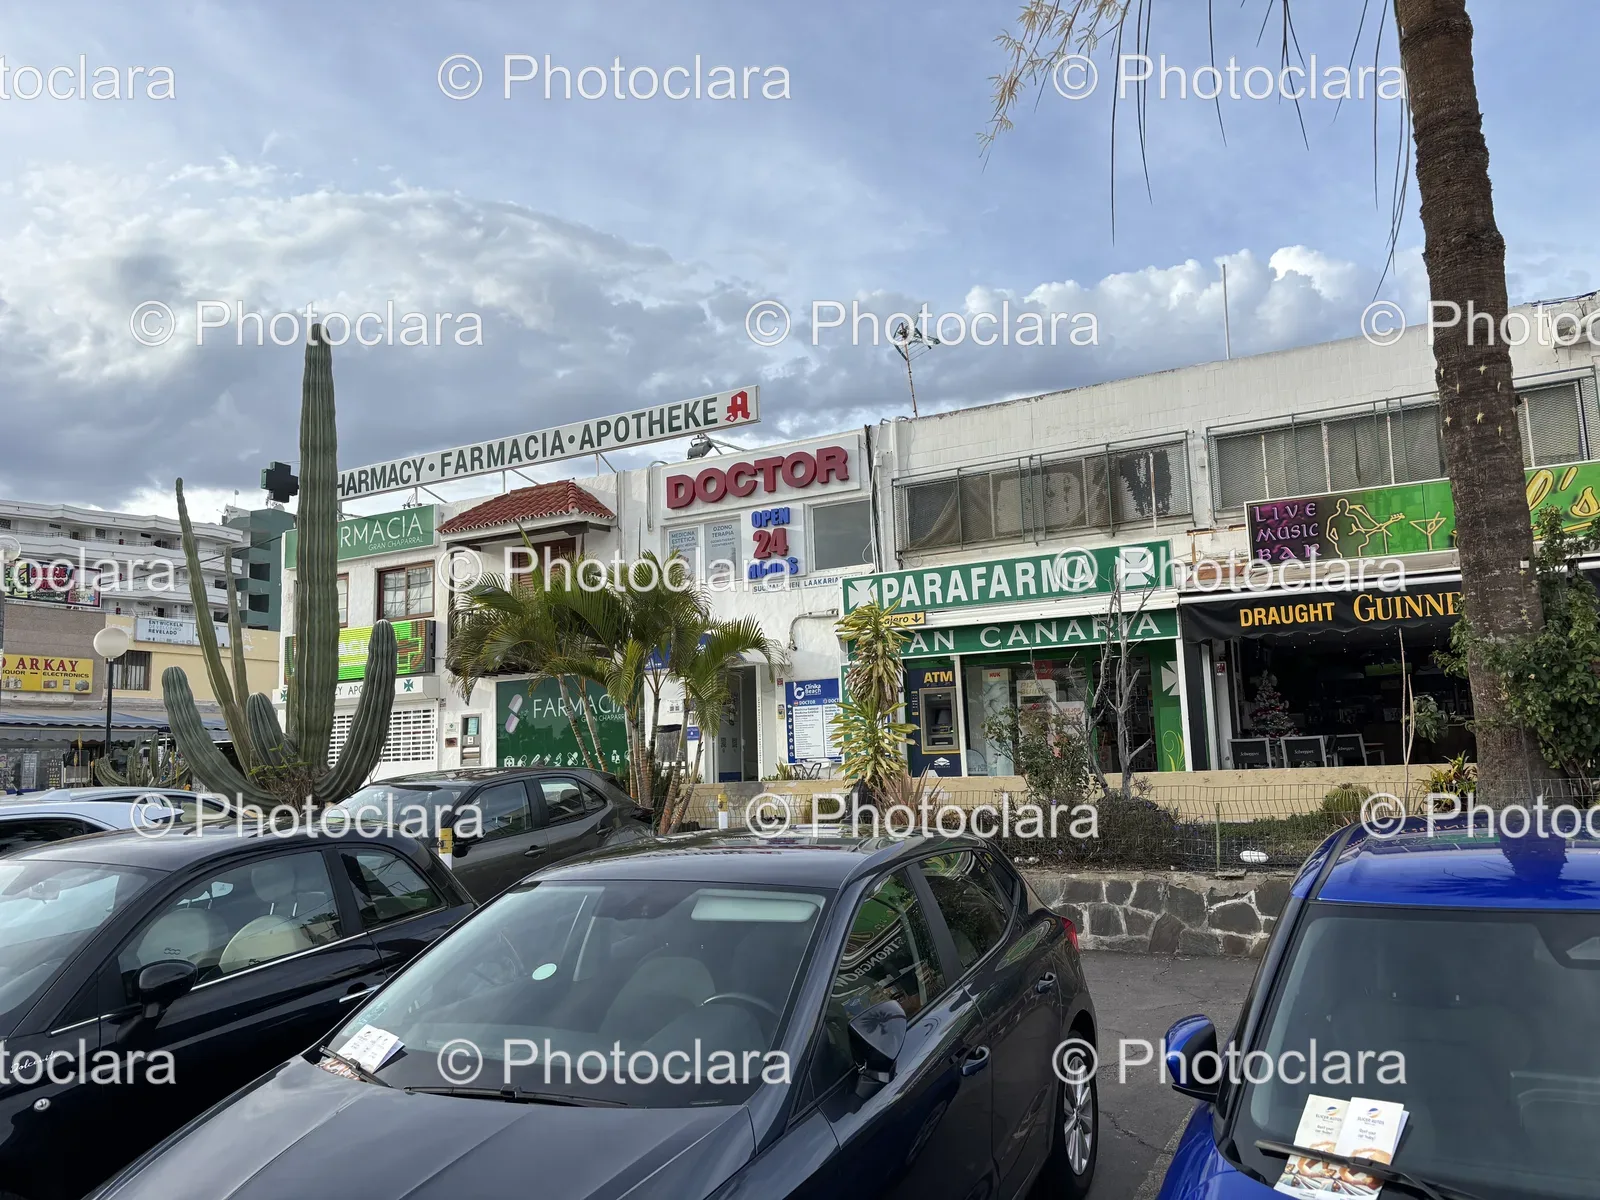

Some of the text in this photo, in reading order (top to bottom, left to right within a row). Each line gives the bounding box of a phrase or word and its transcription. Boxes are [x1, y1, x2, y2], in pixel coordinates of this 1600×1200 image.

[337, 457, 425, 497] HARMACY
[441, 429, 564, 477] FARMACIA
[579, 396, 718, 451] APOTHEKE
[667, 446, 849, 509] DOCTOR
[752, 507, 790, 528] OPEN
[1253, 503, 1317, 522] LIVE
[340, 512, 423, 548] RMACIA
[712, 530, 734, 538] TERAPIA
[1256, 523, 1319, 542] MUSIC
[368, 535, 424, 551] GRAN CHAPARRAL
[753, 528, 789, 559] 24
[1256, 544, 1321, 561] BAR
[753, 577, 838, 593] SUOALANEN LAAKARIA
[882, 555, 1096, 609] PARAFARMA
[1240, 602, 1335, 627] DRAUGHT
[1353, 592, 1460, 622] GUINNE
[148, 619, 183, 627] ENTWICKELN
[885, 616, 908, 625] ajero
[899, 613, 1161, 654] AN CANARIA
[16, 657, 78, 672] ARKAY
[924, 671, 952, 683] ATM
